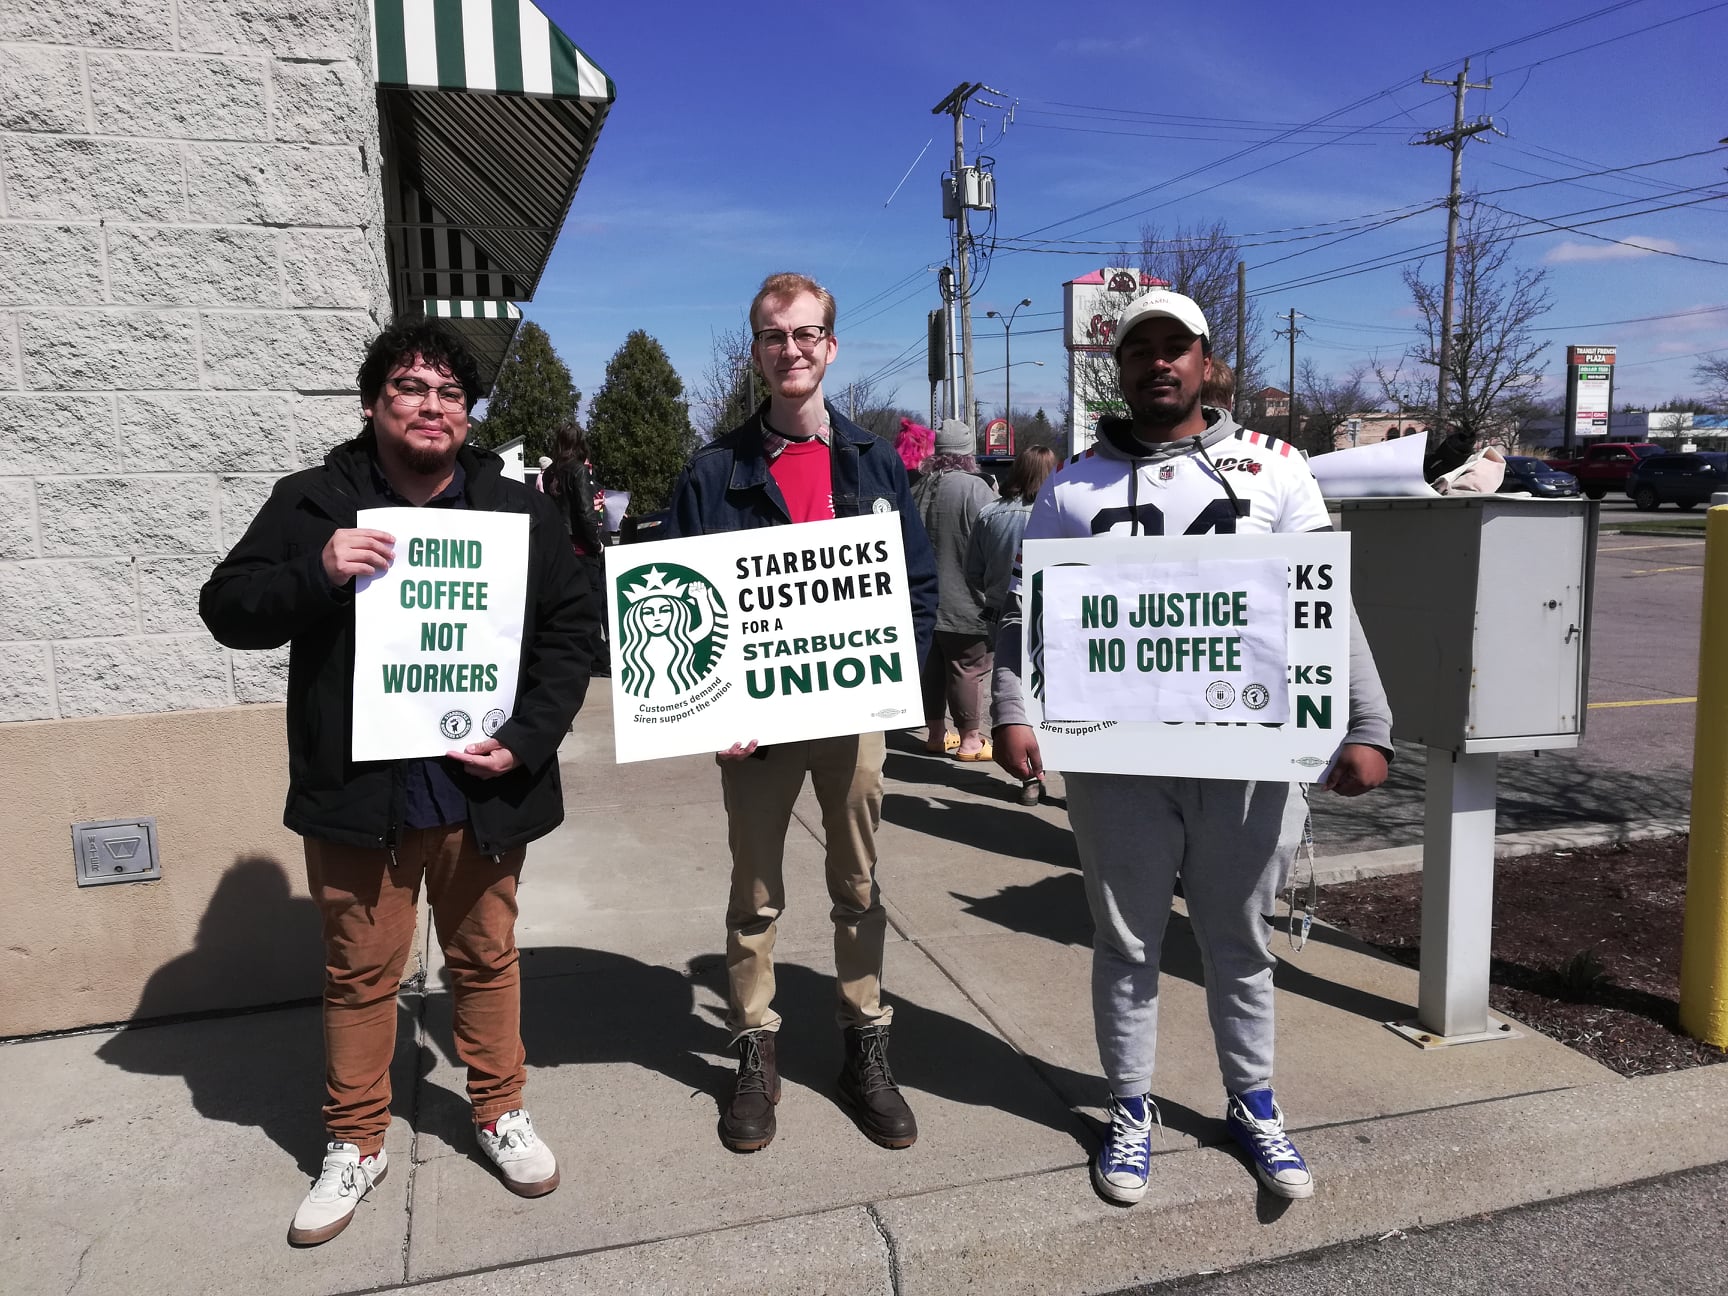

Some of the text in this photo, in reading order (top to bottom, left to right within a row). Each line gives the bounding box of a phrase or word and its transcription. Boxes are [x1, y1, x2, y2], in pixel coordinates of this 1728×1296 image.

[408, 537, 483, 569] GRIND
[736, 540, 889, 580] STARBUCKS
[400, 579, 488, 611] COFFEE
[738, 571, 893, 612] CUSTOMER
[1081, 591, 1248, 629] NO JUSTICE
[420, 622, 467, 652] NOT
[741, 618, 783, 635] FOR A
[743, 626, 898, 661] STARBUCKS
[1088, 636, 1242, 673] NO COFFEE
[382, 663, 498, 693] WORKERS
[639, 676, 722, 713] Customers demand
[745, 652, 903, 700] UNION
[633, 681, 733, 724] Siren support the union
[1039, 721, 1063, 734] Siren
[1065, 723, 1102, 736] support
[88, 834, 100, 871] WATER
